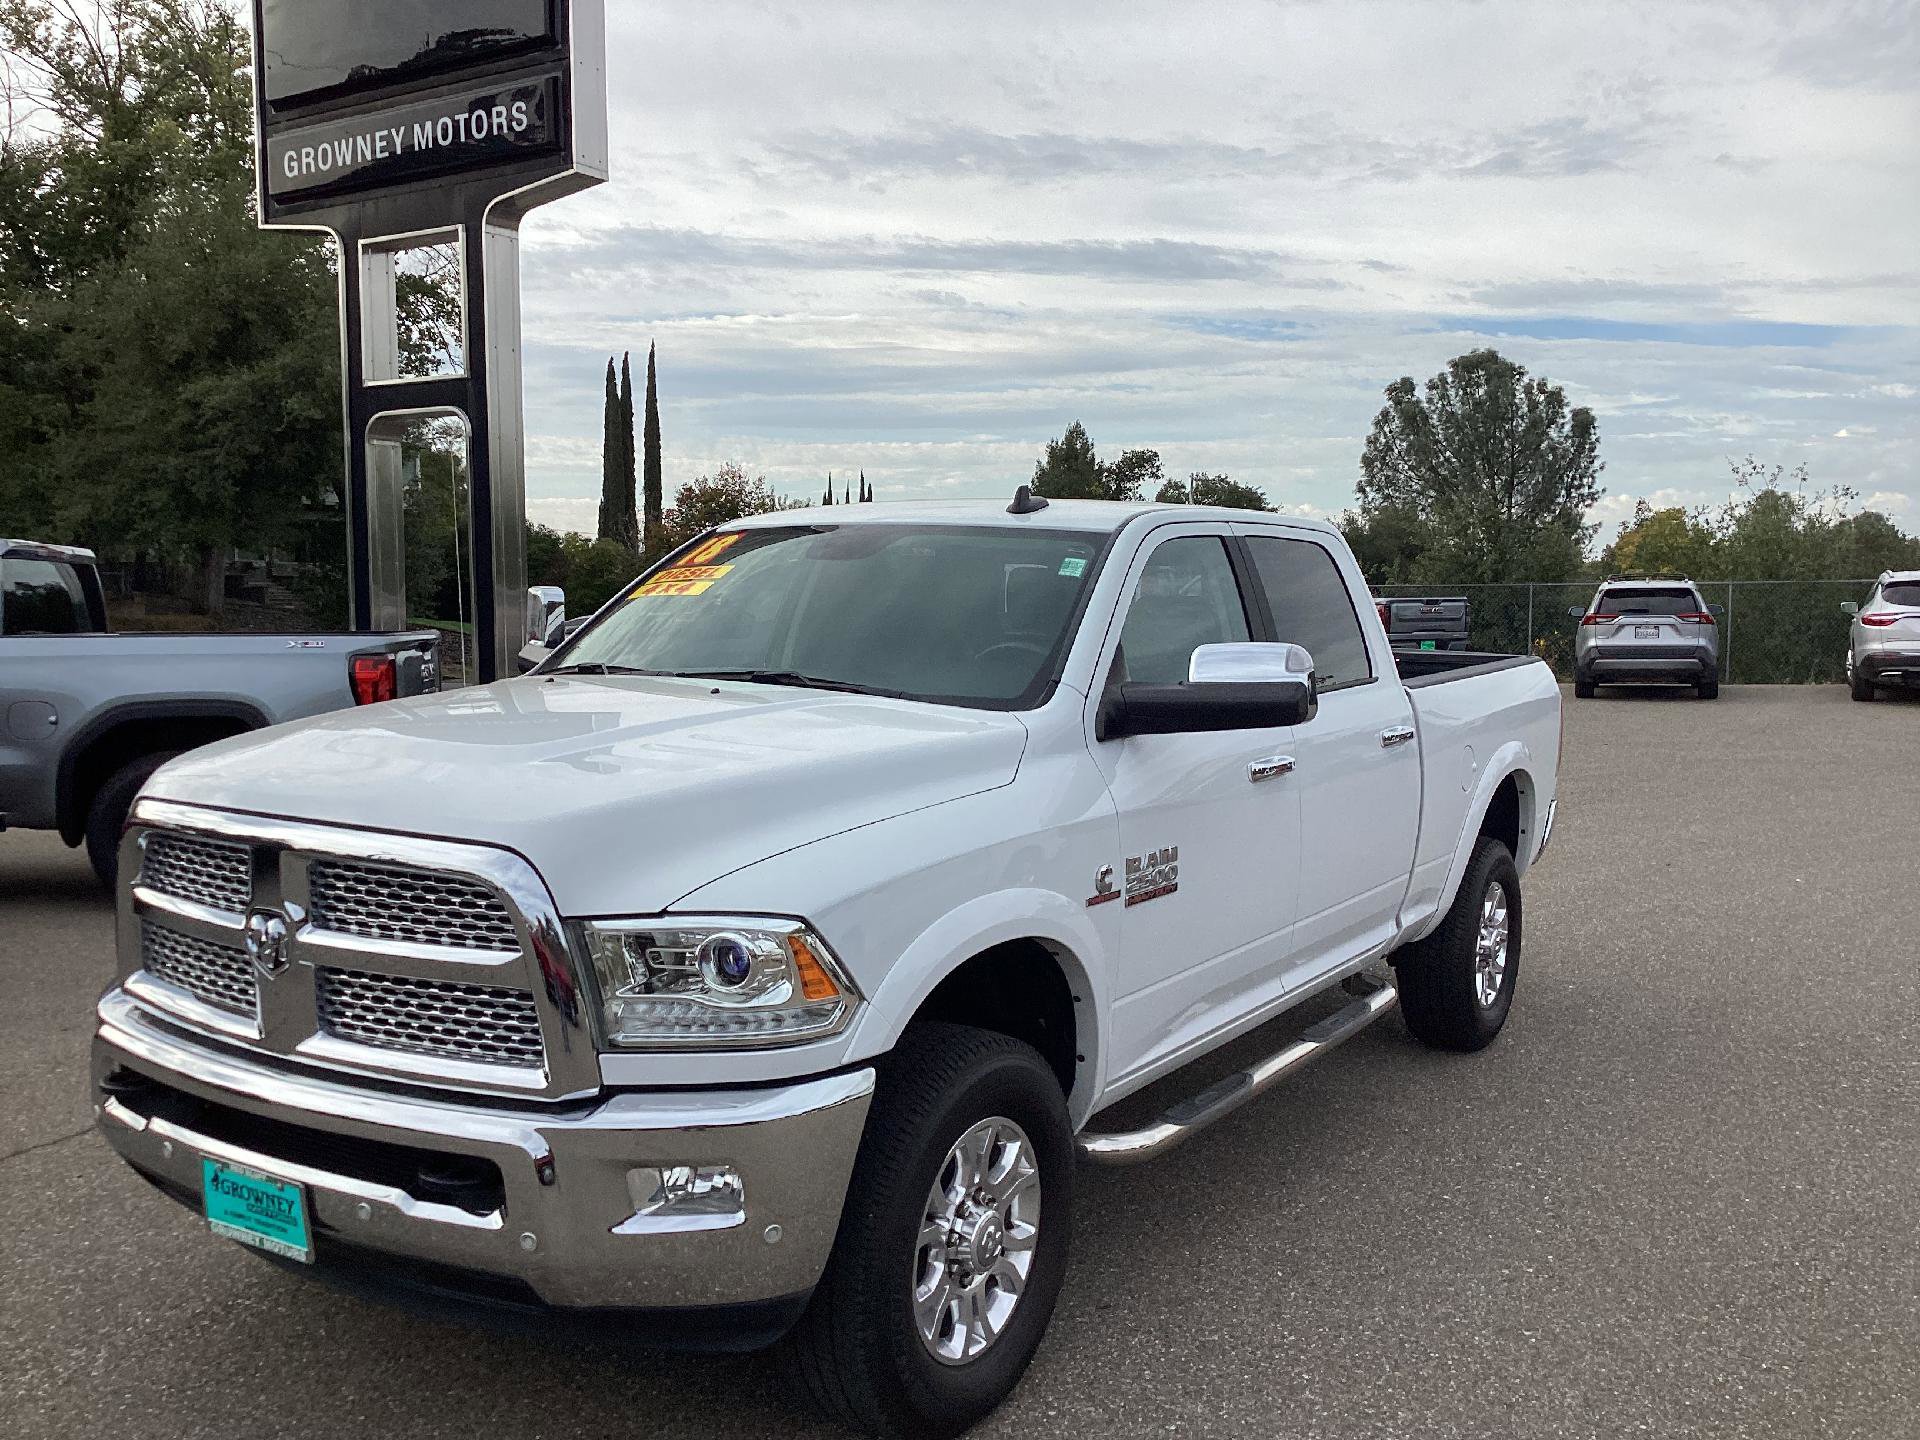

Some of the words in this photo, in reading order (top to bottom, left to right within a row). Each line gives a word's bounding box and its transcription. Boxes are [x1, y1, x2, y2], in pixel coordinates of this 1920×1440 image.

[283, 125, 405, 178] GROWNEY
[412, 101, 529, 152] MOTORS
[656, 566, 718, 581] DIESEL
[1125, 845, 1178, 877] RAM
[1125, 863, 1179, 895] 2500
[221, 1178, 295, 1216] GROWNEY
